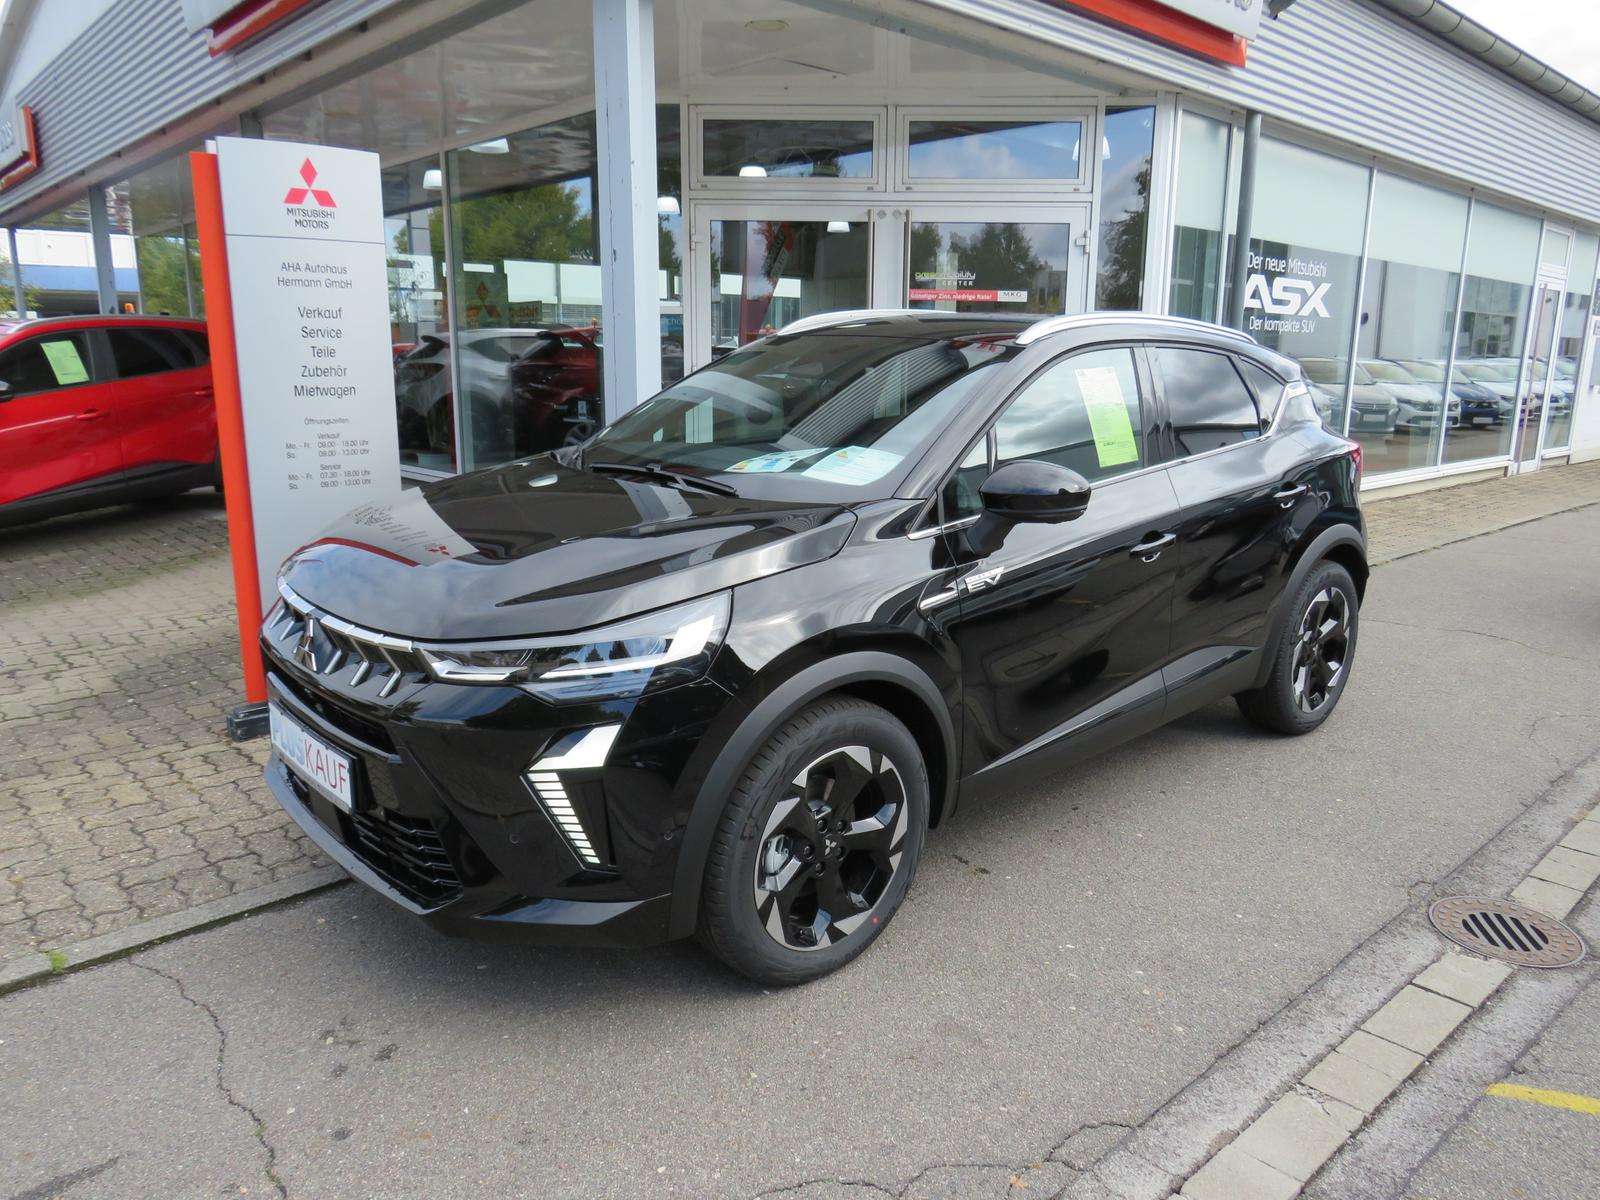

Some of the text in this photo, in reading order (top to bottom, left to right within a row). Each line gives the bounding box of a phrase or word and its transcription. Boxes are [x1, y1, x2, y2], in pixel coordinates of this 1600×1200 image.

[286, 207, 335, 220] MITSUBISHI
[294, 219, 329, 230] MOTORS
[281, 262, 347, 275] AHA Autohaus
[1247, 252, 1327, 277] Der neue Mitsubishi
[325, 278, 353, 289] GmbH
[1243, 273, 1332, 318] ASX
[298, 306, 342, 319] Verkauf
[1249, 316, 1316, 334] Der kompakte SUV
[301, 326, 343, 339] Service
[310, 346, 336, 358] Teile
[301, 365, 347, 378] Zubehör
[294, 385, 356, 399] Mietwagen
[317, 432, 340, 440] Verkauf
[319, 463, 341, 471] Service
